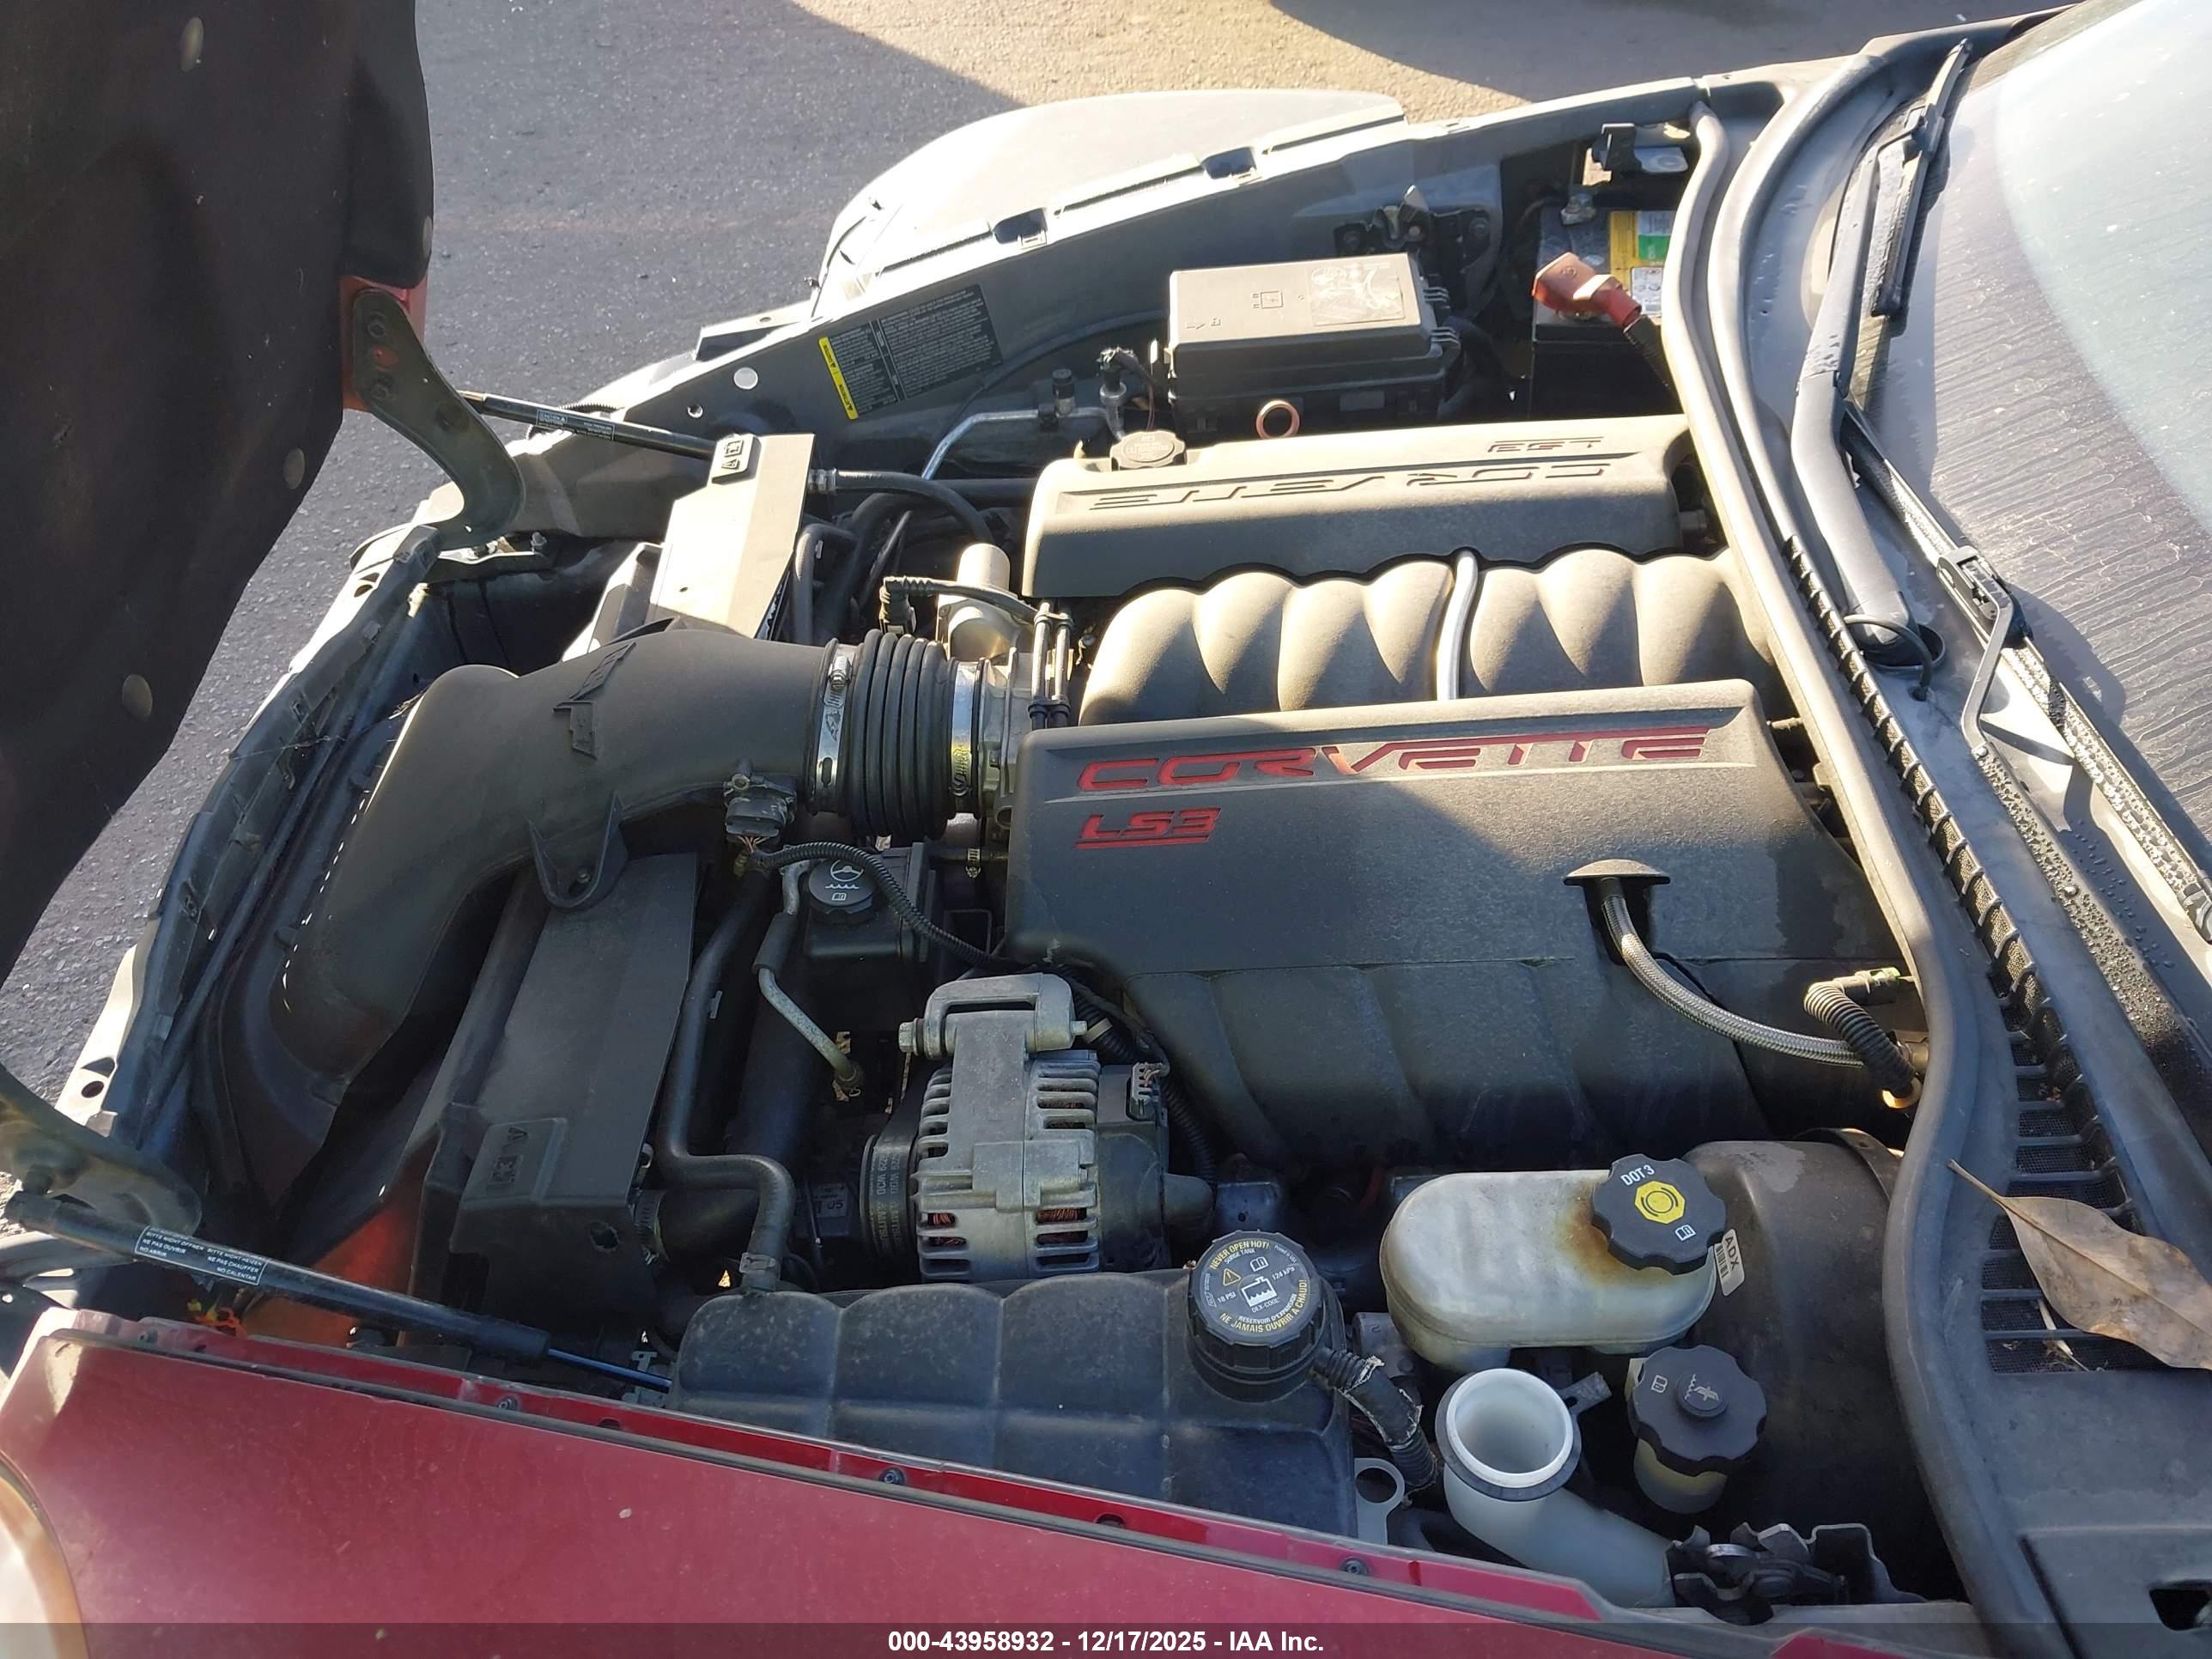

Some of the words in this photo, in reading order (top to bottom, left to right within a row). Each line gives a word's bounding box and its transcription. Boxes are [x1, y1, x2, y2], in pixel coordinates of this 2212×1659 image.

[1077, 726, 1711, 791] CORVETTE
[1079, 806, 1222, 840] LS3
[1620, 1167, 1645, 1186] DOT
[1644, 1164, 1656, 1176] 3
[1209, 1249, 1231, 1270] NEVER
[1229, 1241, 1249, 1253] OPEN
[1250, 1240, 1270, 1249] HOT!
[1224, 1251, 1241, 1265] SURGE
[1725, 1236, 1740, 1271] ADX
[1272, 1271, 1283, 1280] 124
[1282, 1267, 1295, 1276] kPa
[1219, 1313, 1232, 1324] NE
[1231, 1320, 1264, 1333] JAMAIS
[1265, 1313, 1294, 1332] OUVRIR
[1294, 1279, 1308, 1309] CHAUD!
[1224, 1291, 1237, 1300] PSI
[1237, 1316, 1271, 1325] RESERVOIR
